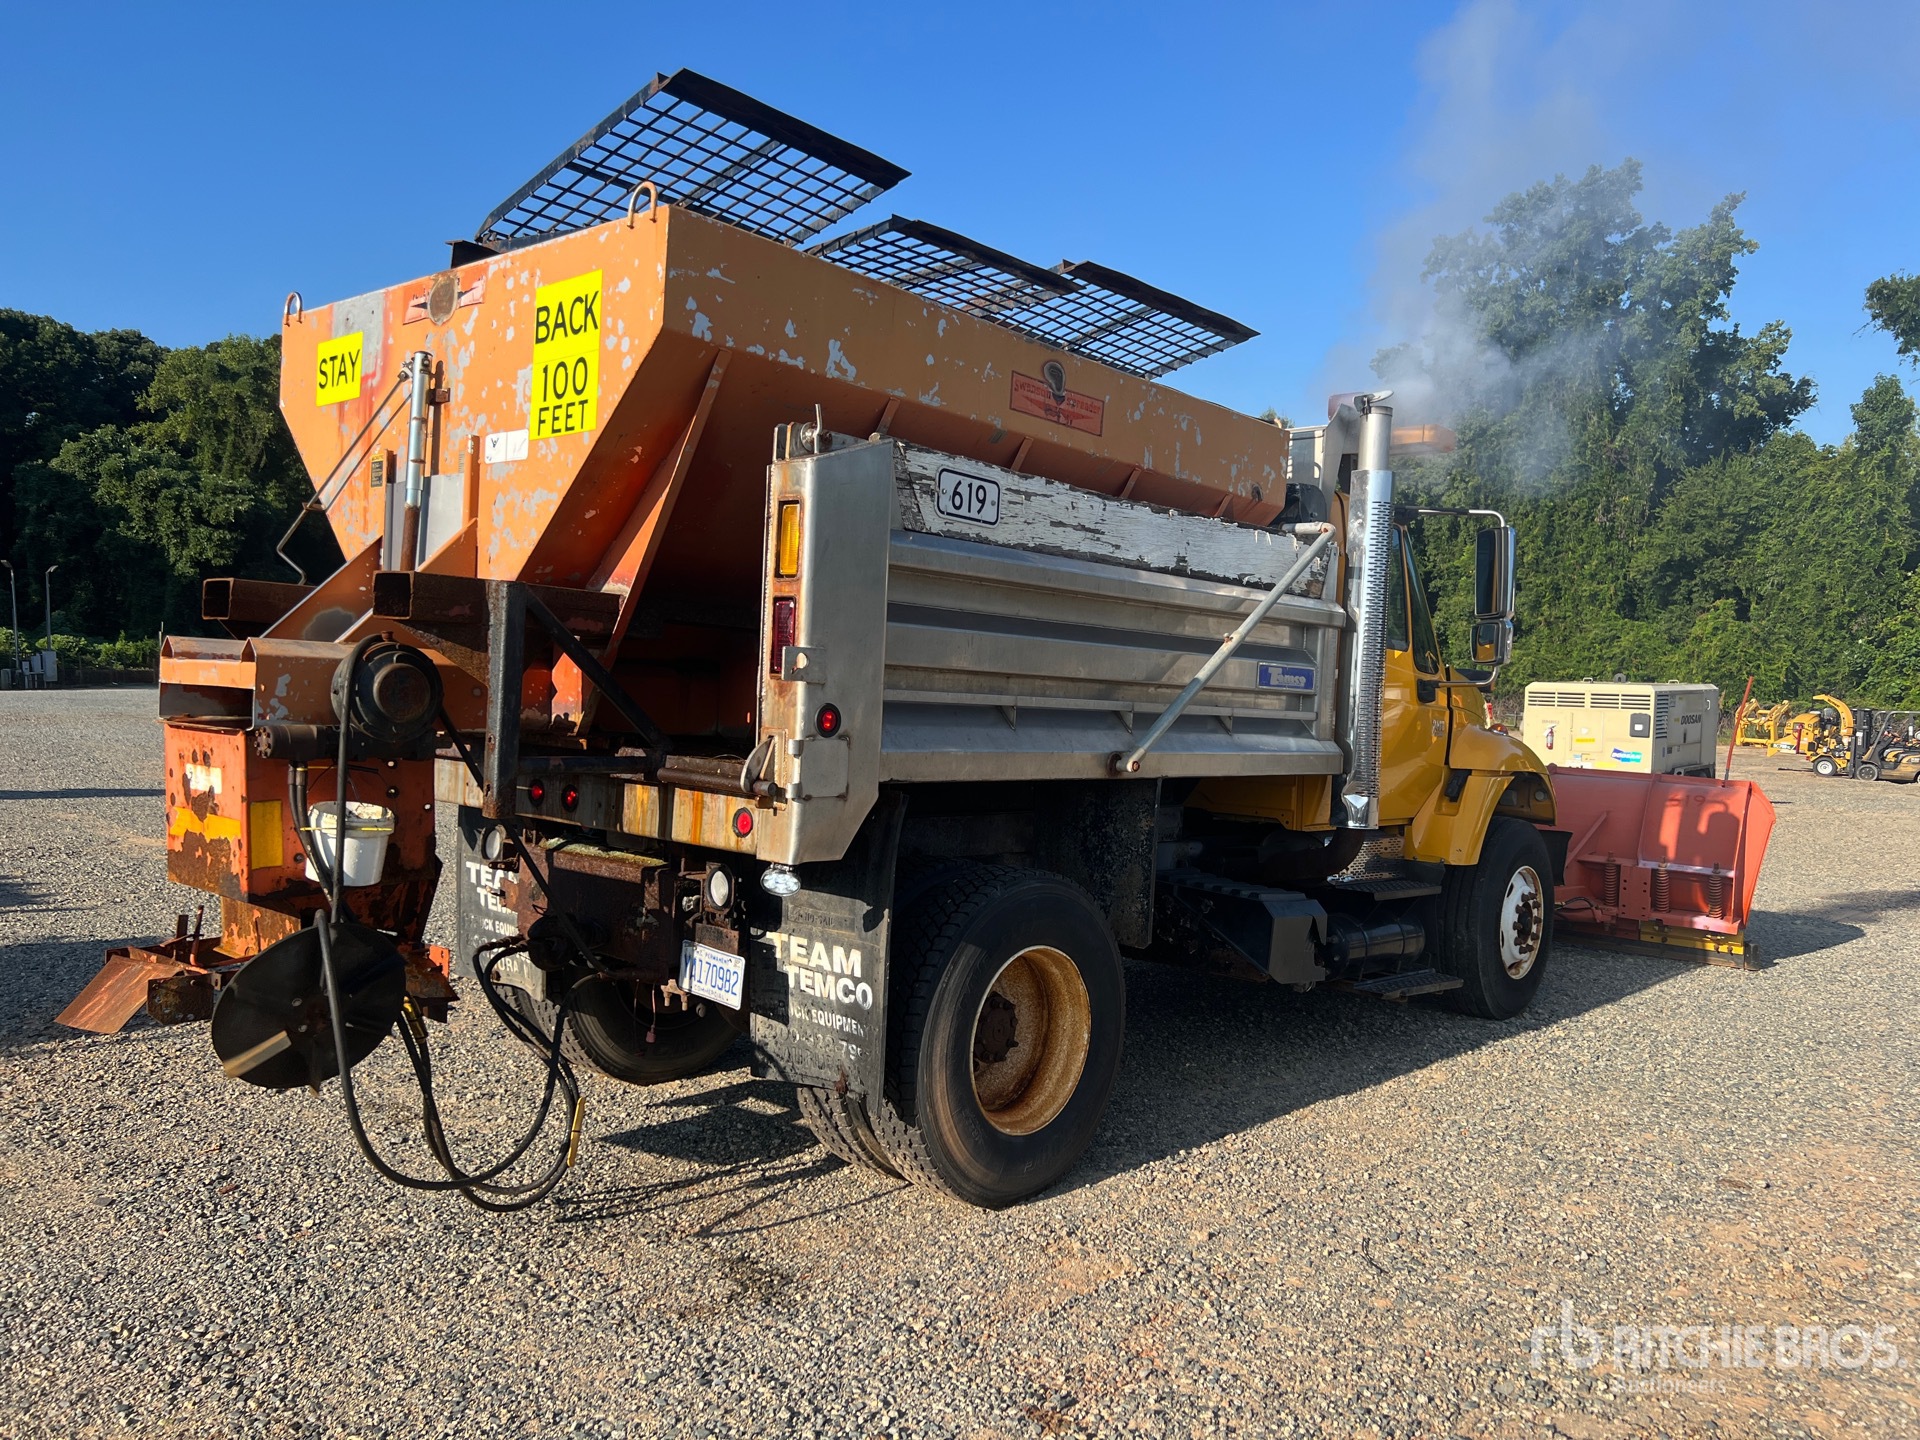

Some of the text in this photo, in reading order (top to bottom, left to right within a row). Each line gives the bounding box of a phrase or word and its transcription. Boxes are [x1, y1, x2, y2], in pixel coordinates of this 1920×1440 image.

[535, 291, 599, 345] BACK
[318, 349, 361, 389] STAY
[542, 357, 588, 402] 100
[538, 399, 588, 436] FEET
[952, 480, 987, 515] 619
[684, 953, 739, 996] YA170982
[766, 932, 862, 978] TEAM
[784, 965, 873, 1010] TEMCO
